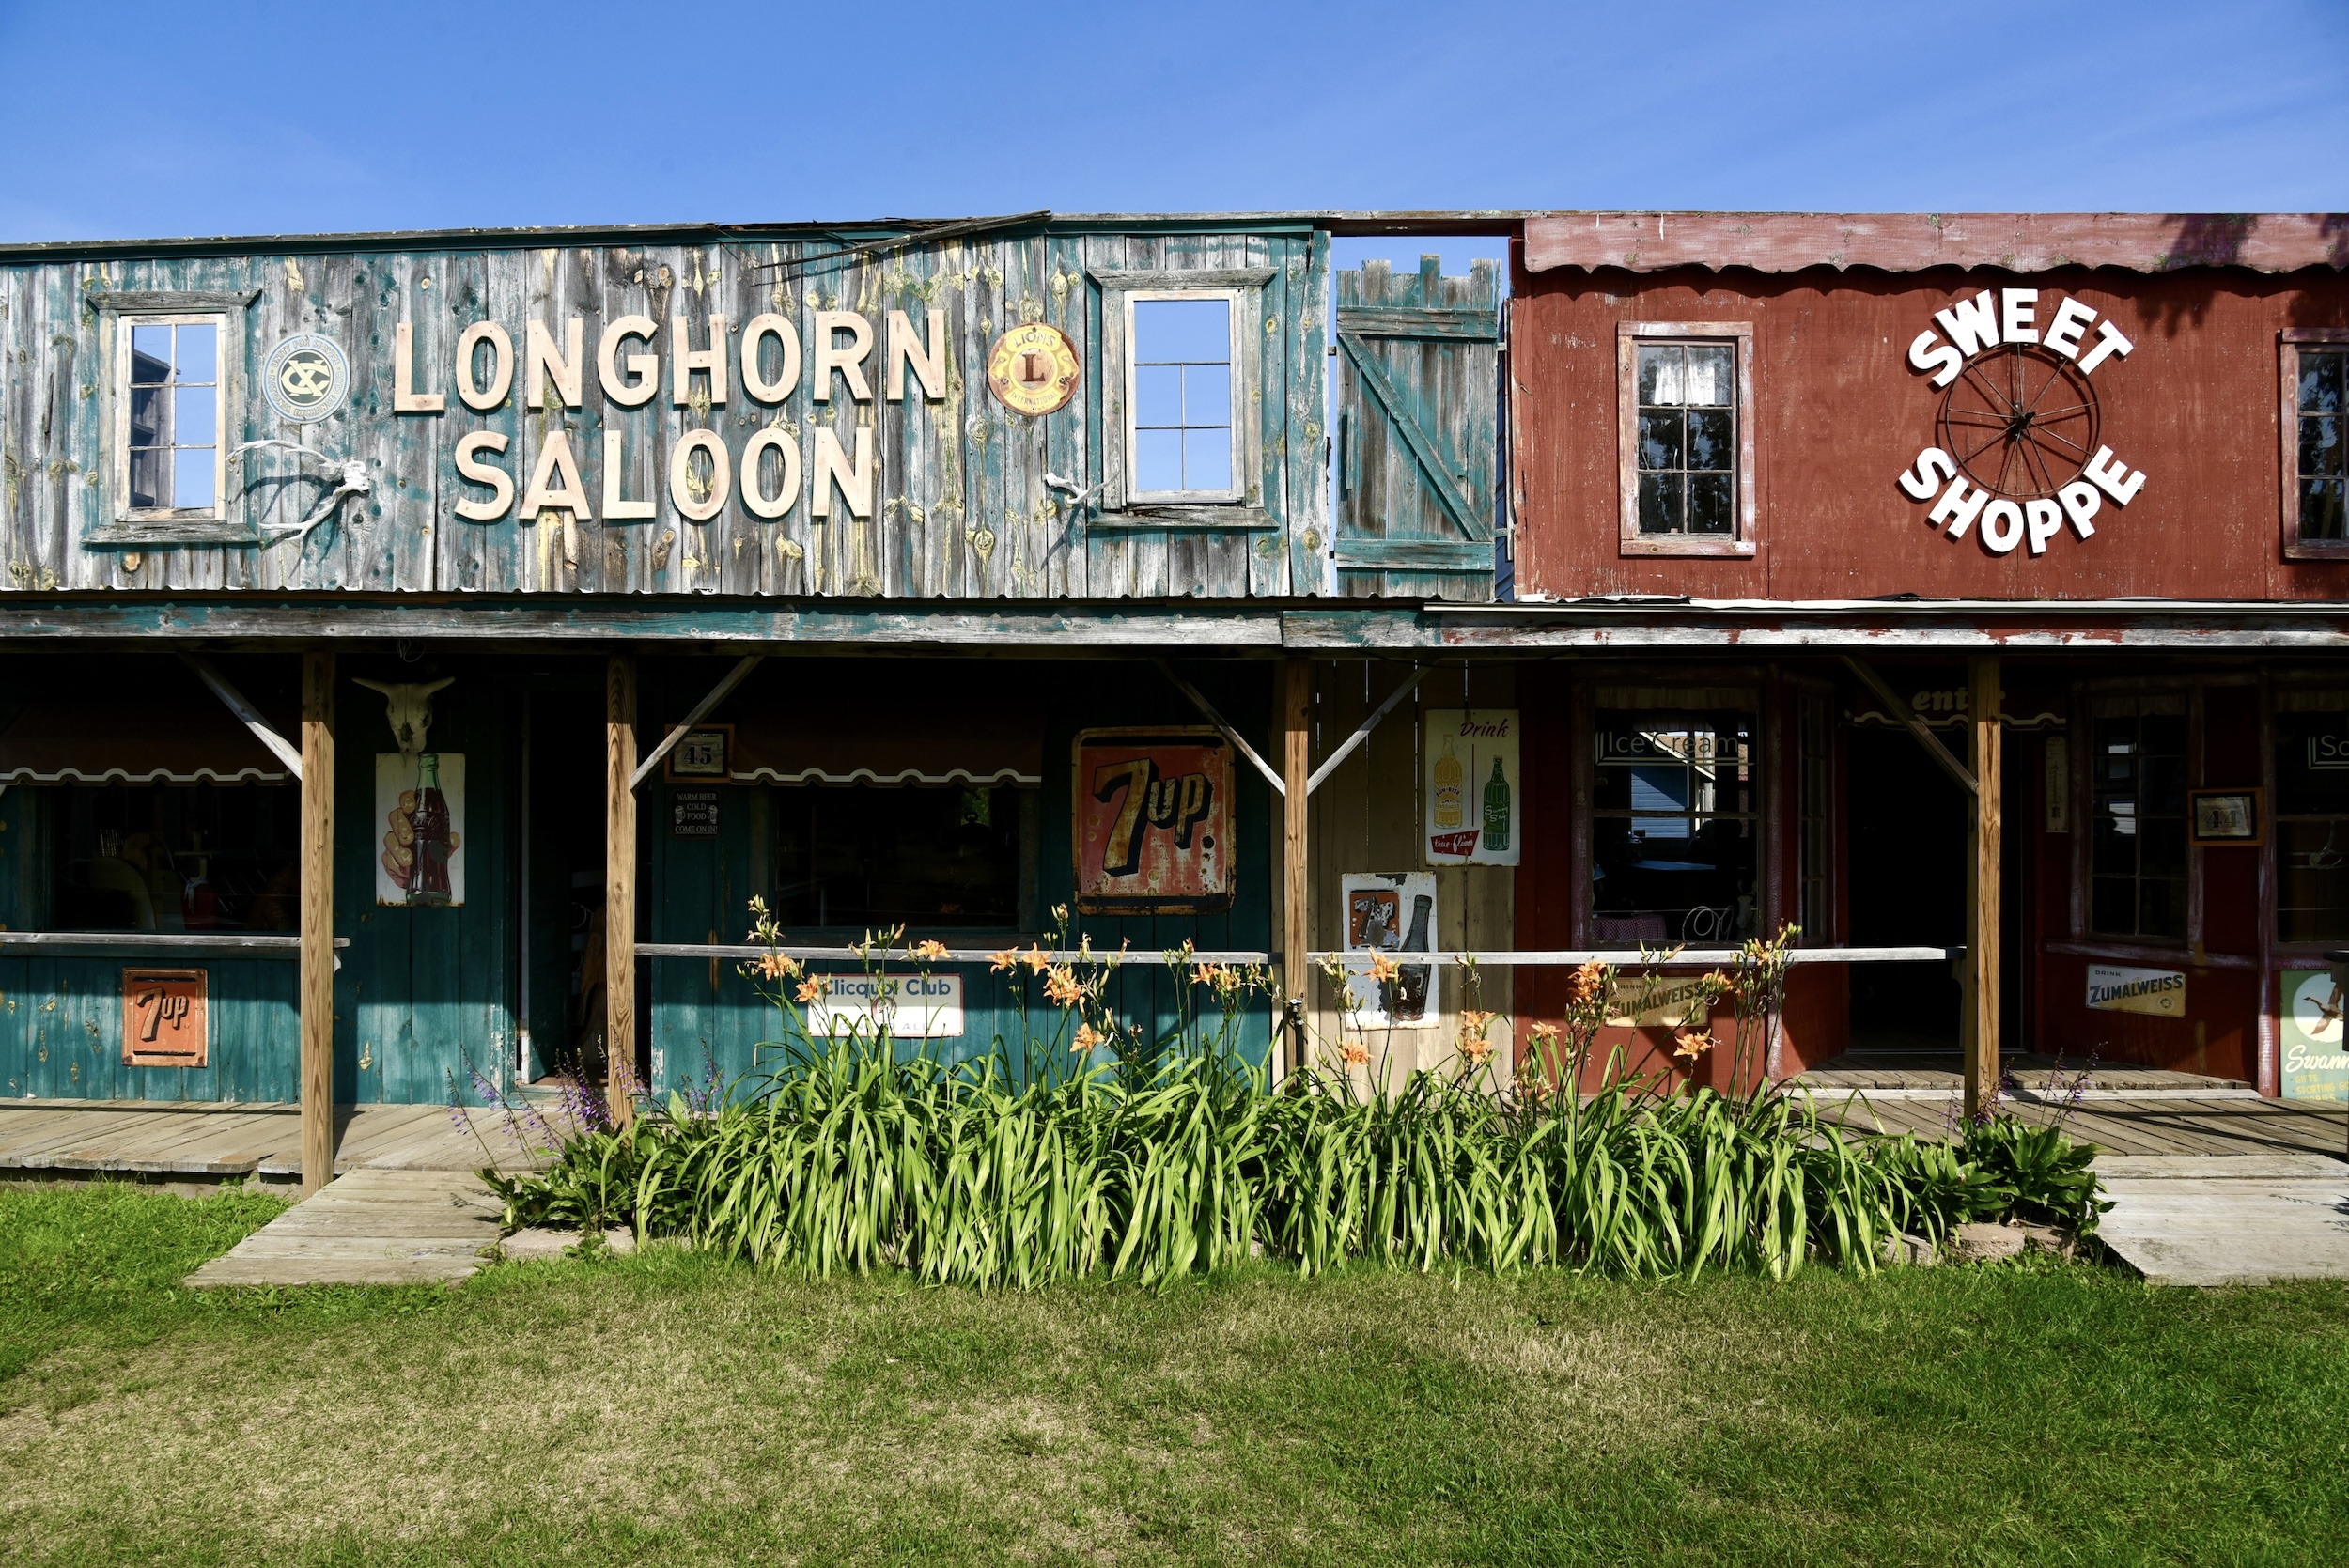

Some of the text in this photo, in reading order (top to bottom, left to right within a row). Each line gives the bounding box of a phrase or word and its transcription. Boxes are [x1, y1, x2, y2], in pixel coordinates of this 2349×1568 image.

[1013, 332, 1056, 348] LIONS
[1908, 287, 2134, 387] SWEET
[272, 338, 341, 367] UNITY FOR SERVICE
[394, 309, 946, 412] LONGHORN
[1021, 353, 1046, 382] L
[268, 375, 292, 412] NATIONAL
[293, 394, 336, 417] EXCHANGE
[1010, 391, 1059, 405] INTERNATIONAL
[453, 427, 873, 520] SALOON
[1898, 443, 2147, 554] SHOPPE
[1460, 718, 1509, 737] Drink
[1609, 731, 1738, 753] Ice Cream
[683, 746, 712, 765] 45
[675, 825, 718, 833] COME ON IN!
[2206, 810, 2240, 828] 44
[906, 979, 951, 996] Club
[2089, 974, 2184, 1004] ZUMALWEISS
[2295, 1074, 2318, 1083] GIFTS
[2296, 1082, 2336, 1095] SPORTING
